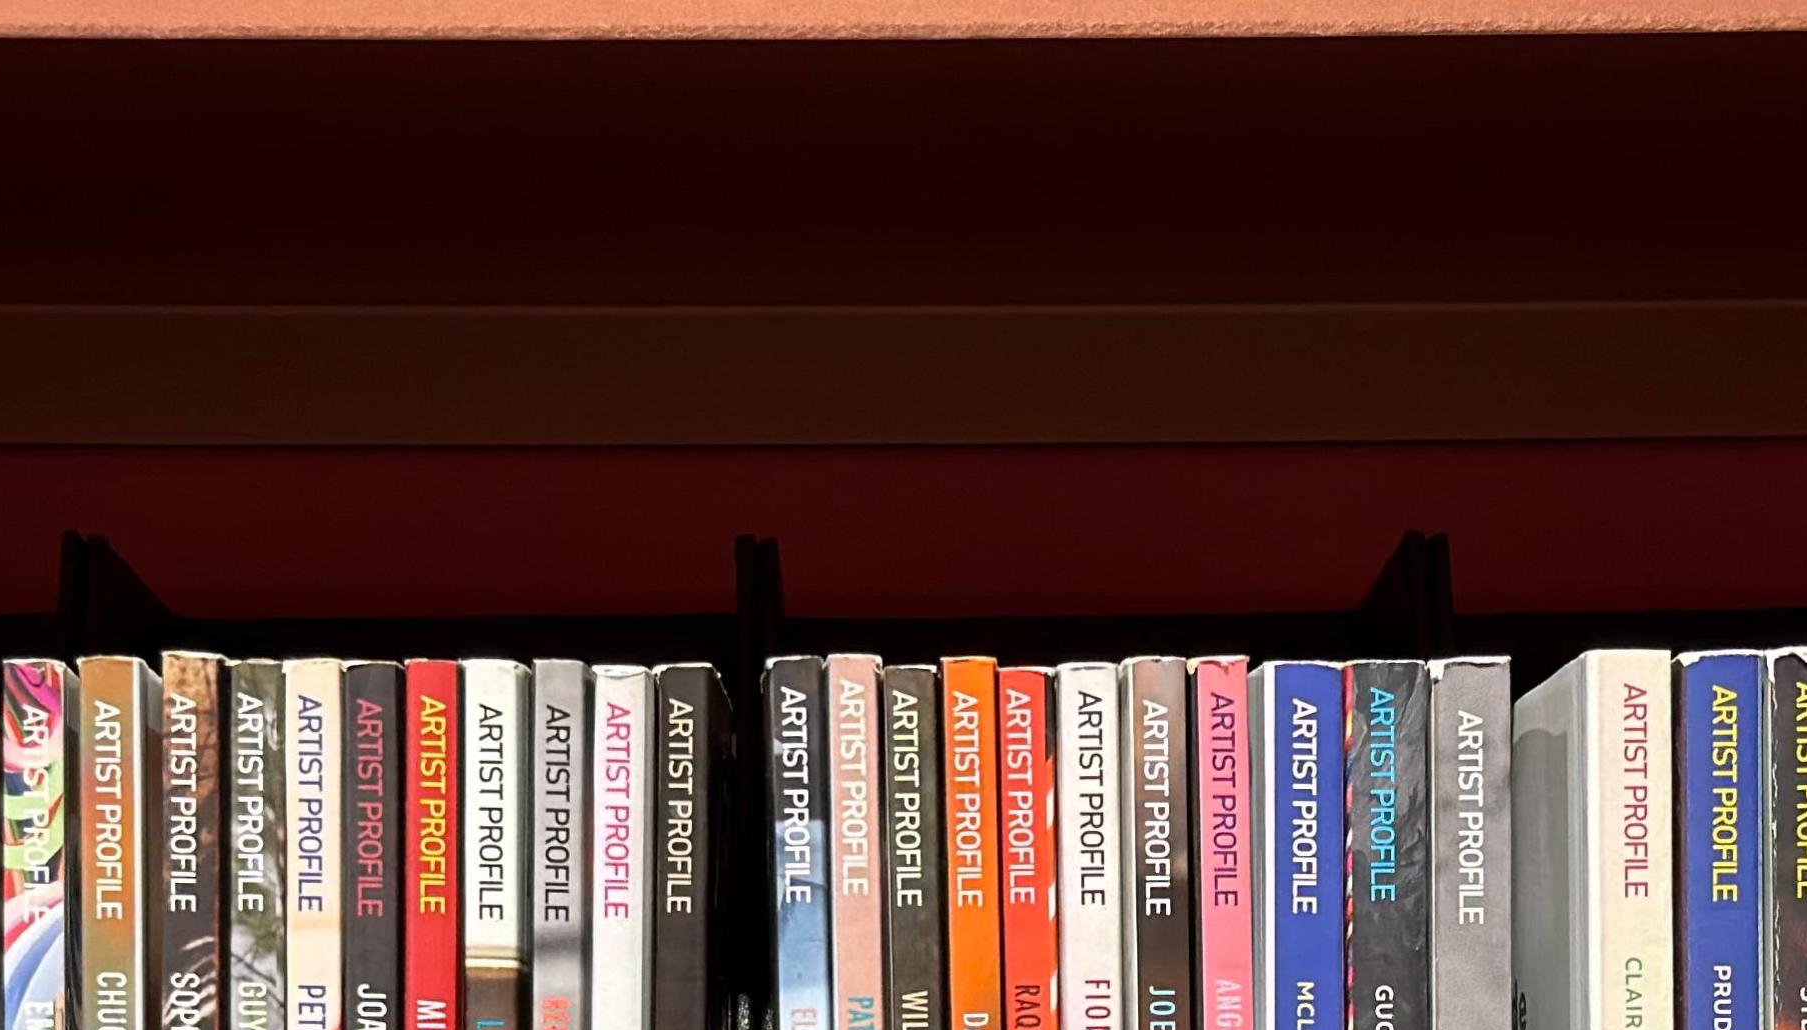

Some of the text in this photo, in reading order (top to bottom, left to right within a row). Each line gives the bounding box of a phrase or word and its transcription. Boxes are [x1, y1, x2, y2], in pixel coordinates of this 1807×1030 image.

[94, 701, 121, 919] ARTIST PROFILE
[237, 692, 263, 911] ARTIST PROFILE
[419, 696, 445, 913] ARTIST PROFILE
[545, 705, 570, 922] ARTIST PROFILE
[667, 699, 692, 912] ARTIST PROFILE
[893, 691, 921, 906] ARTIST PROFILE
[1006, 689, 1034, 904] ARTIST PROFILE
[1077, 691, 1105, 905] ARTIST PROFILE
[1291, 699, 1317, 914] ARTIST PROFILE
[1458, 710, 1483, 924] ARTIST PROFILE
[1711, 685, 1737, 902] ARTIST PROFILE
